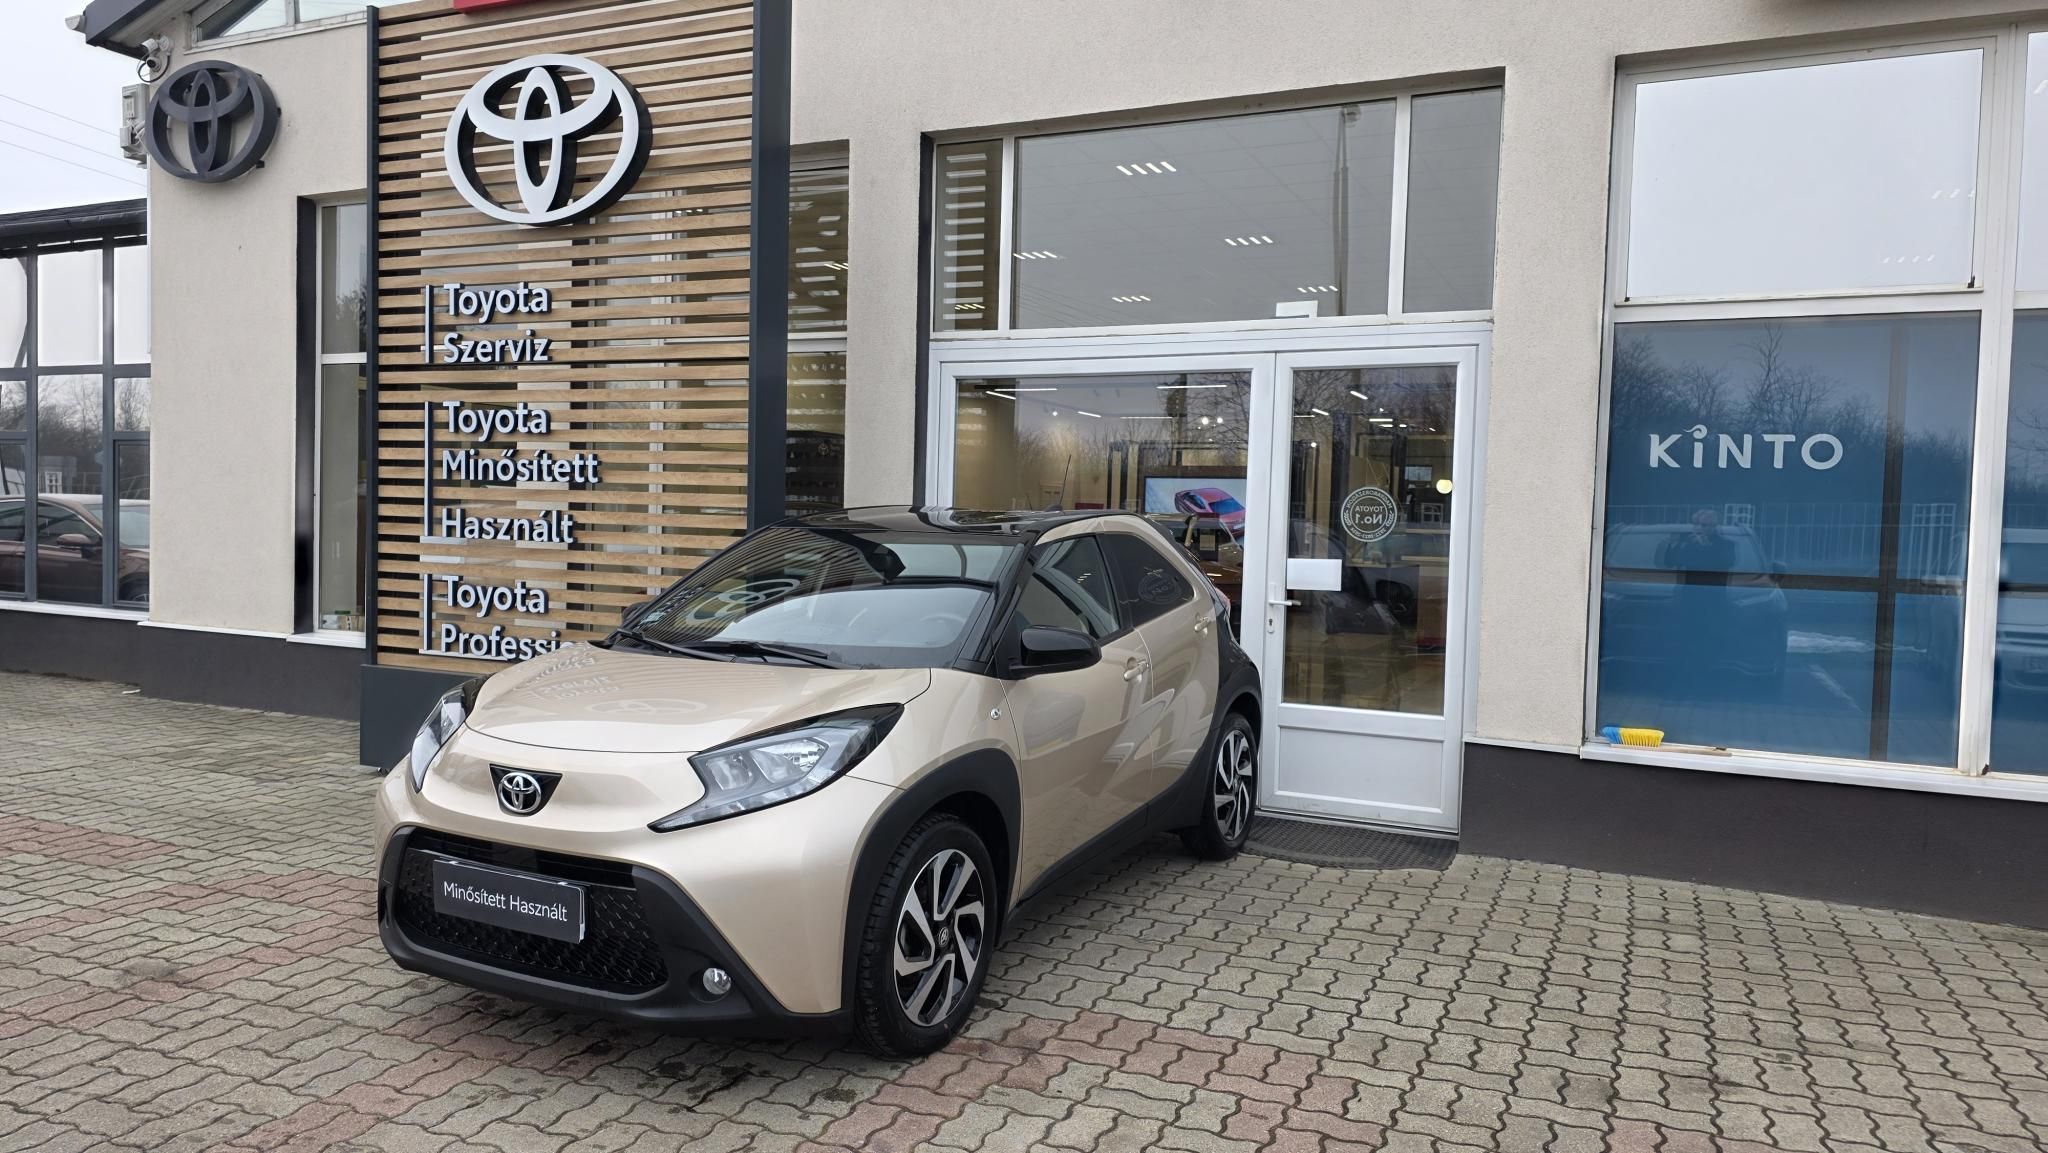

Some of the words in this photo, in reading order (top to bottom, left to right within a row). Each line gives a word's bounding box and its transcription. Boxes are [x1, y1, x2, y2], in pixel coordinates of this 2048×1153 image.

[443, 282, 550, 324] Toyota
[443, 329, 551, 363] Szerviz
[442, 400, 549, 442] Toyota
[441, 449, 600, 483] Minősített
[441, 508, 575, 544] Használt
[442, 575, 547, 618] Toyota
[443, 881, 506, 909] Minősített
[510, 895, 568, 922] Használt
